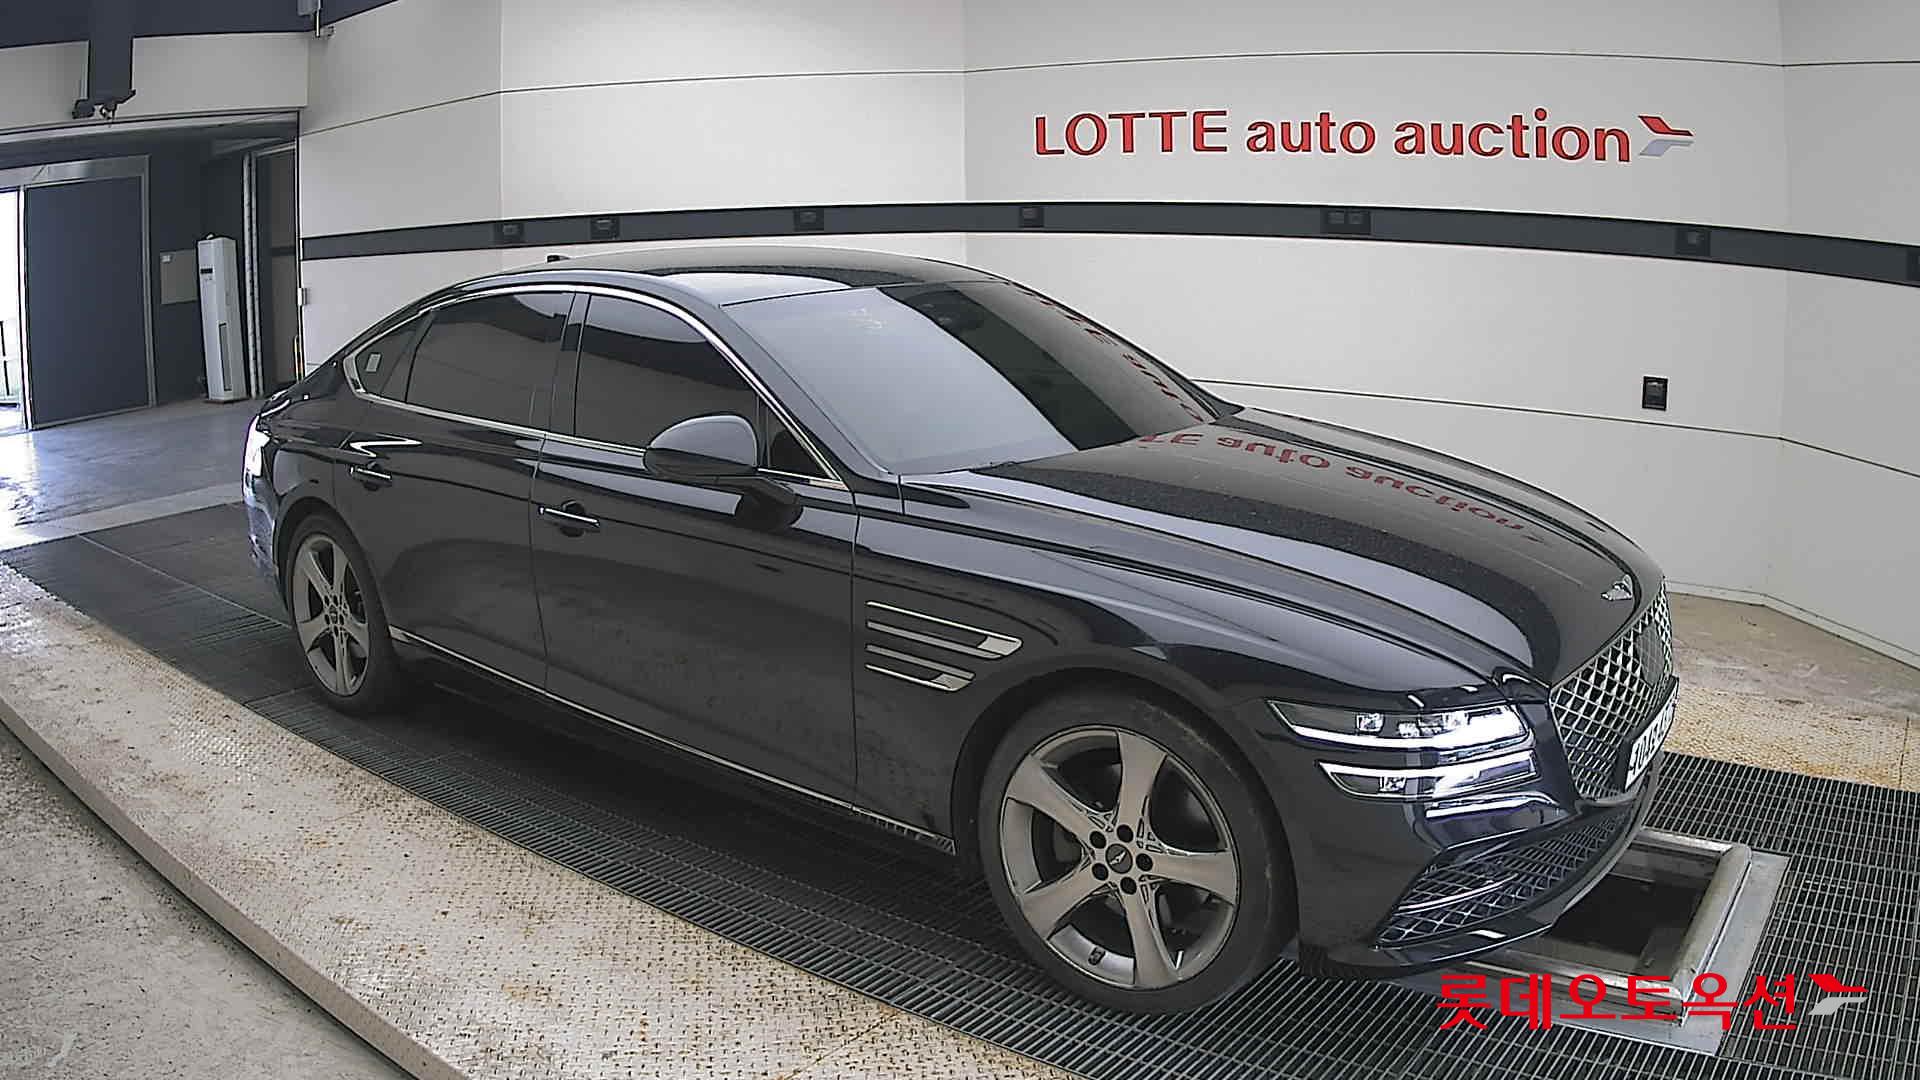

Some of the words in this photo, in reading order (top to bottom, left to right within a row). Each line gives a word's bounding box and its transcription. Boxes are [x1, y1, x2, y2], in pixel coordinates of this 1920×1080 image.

[1034, 110, 1228, 156] LOTTE
[1248, 112, 1376, 154] auto
[1394, 107, 1631, 162] auction
